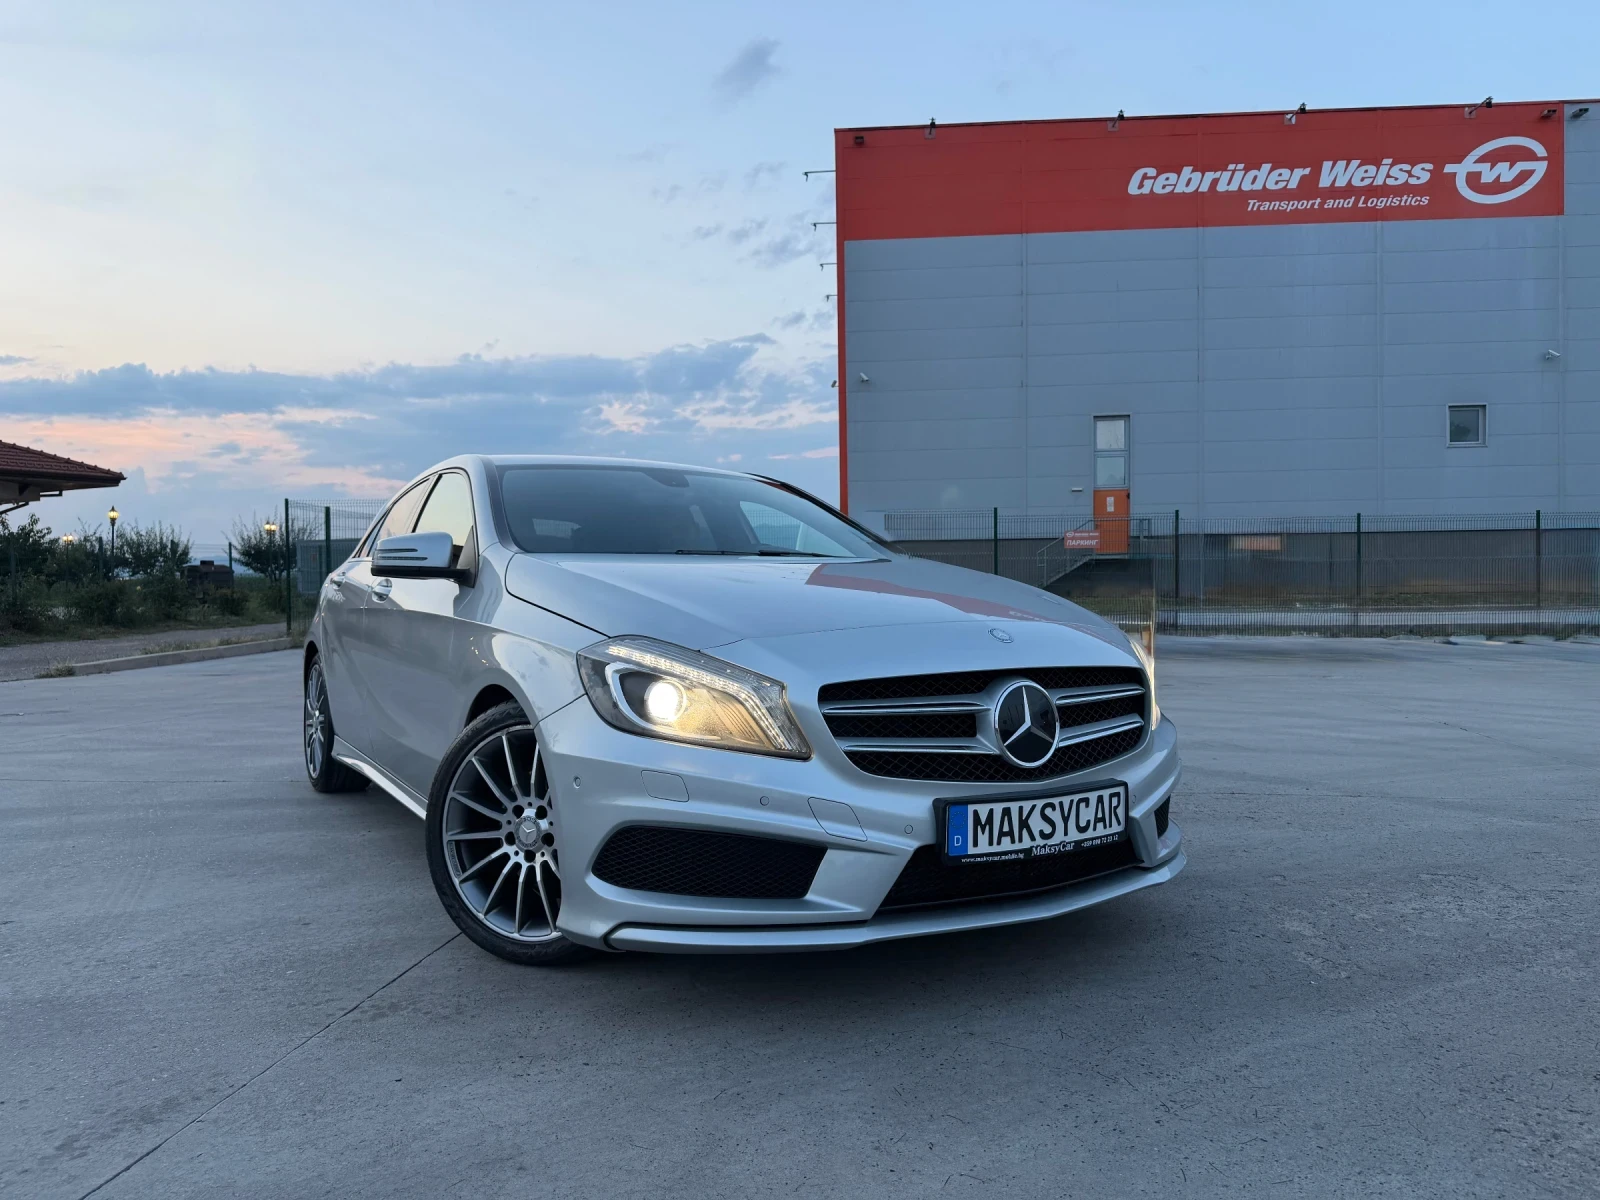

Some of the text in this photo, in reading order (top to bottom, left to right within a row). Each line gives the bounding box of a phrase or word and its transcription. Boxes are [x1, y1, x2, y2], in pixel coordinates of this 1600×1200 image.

[1127, 158, 1433, 195] Gebrüder Weiss
[1247, 193, 1430, 212] Transport and Logistics
[972, 791, 1122, 848] MAKSYCAR
[954, 835, 962, 847] D
[1031, 841, 1075, 857] MaksyCar
